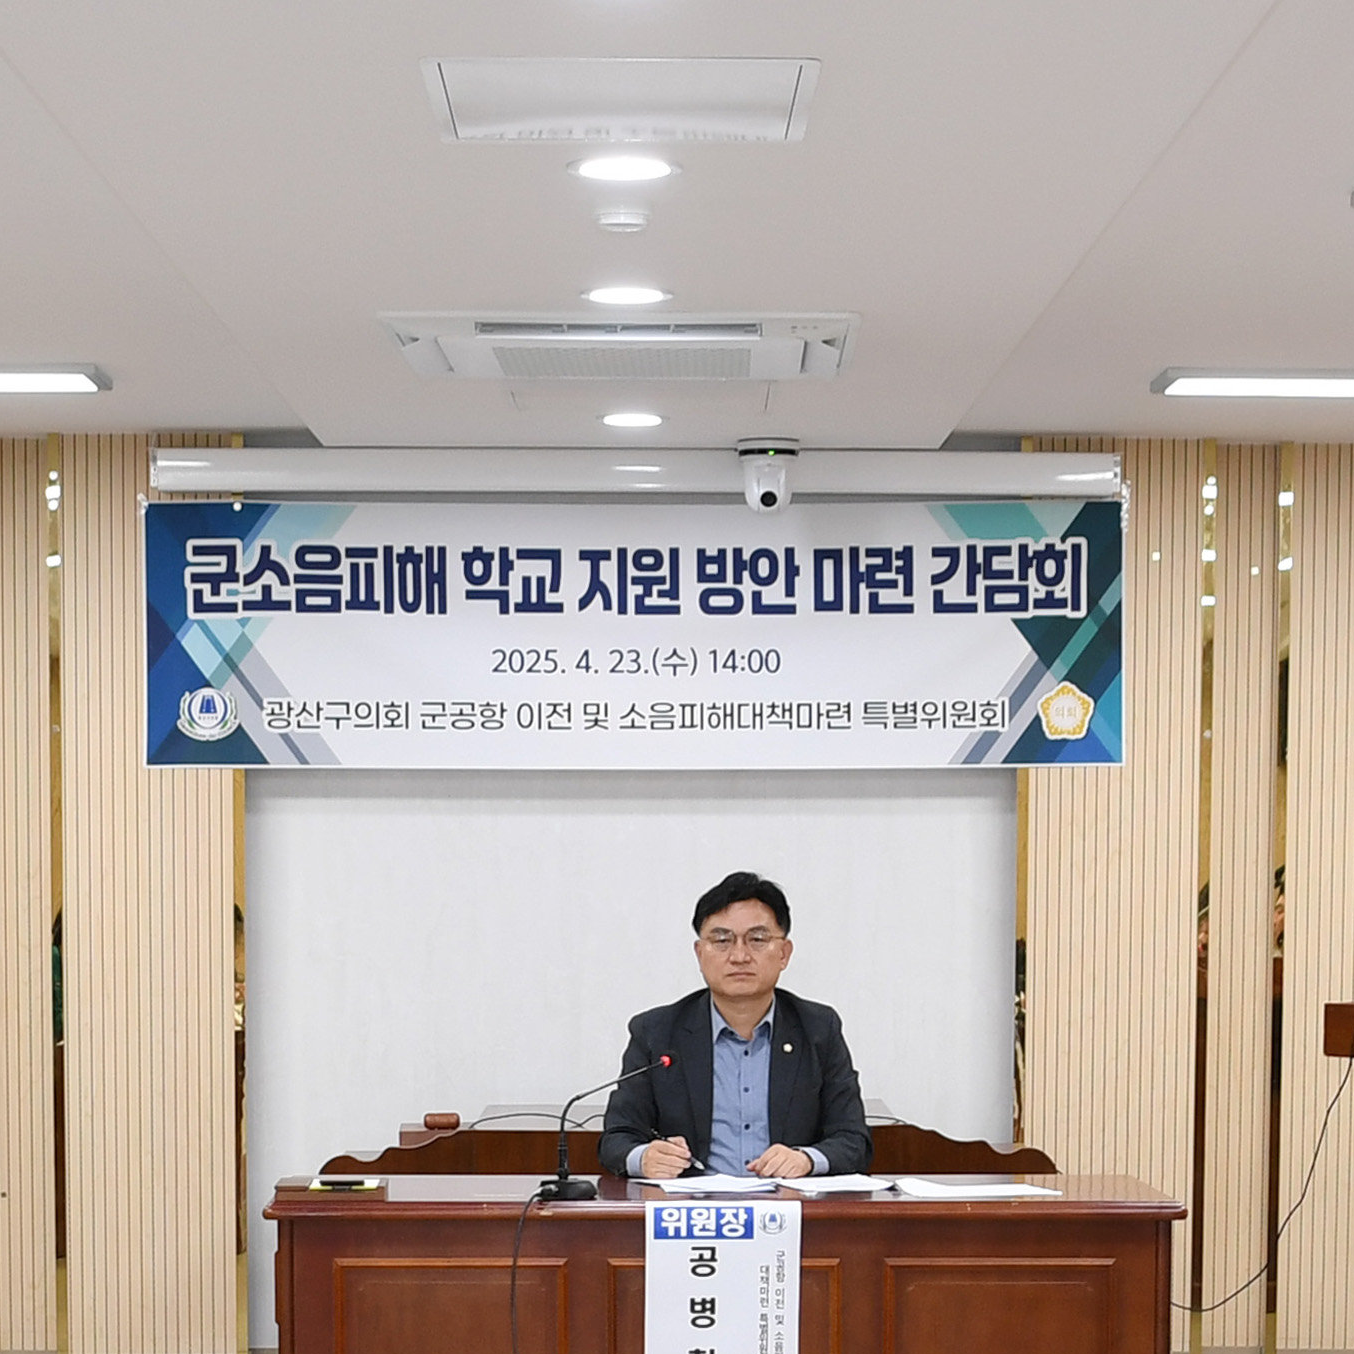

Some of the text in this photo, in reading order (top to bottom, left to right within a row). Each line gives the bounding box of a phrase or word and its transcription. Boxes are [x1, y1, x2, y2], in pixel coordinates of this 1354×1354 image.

[186, 540, 1086, 618] 군소음피해 학교 지원 방안 마련 간담회
[492, 648, 780, 676] 2025. 4. 23.(수) 14:00
[262, 701, 409, 731] 광산구의회
[421, 702, 507, 729] 군공항
[517, 703, 571, 730] 이전
[584, 703, 608, 729] 및
[620, 702, 851, 730] 소음피해대책마련
[862, 702, 1009, 731] 특별위원회
[661, 1208, 747, 1237] 위원장
[774, 1287, 786, 1311] 이전
